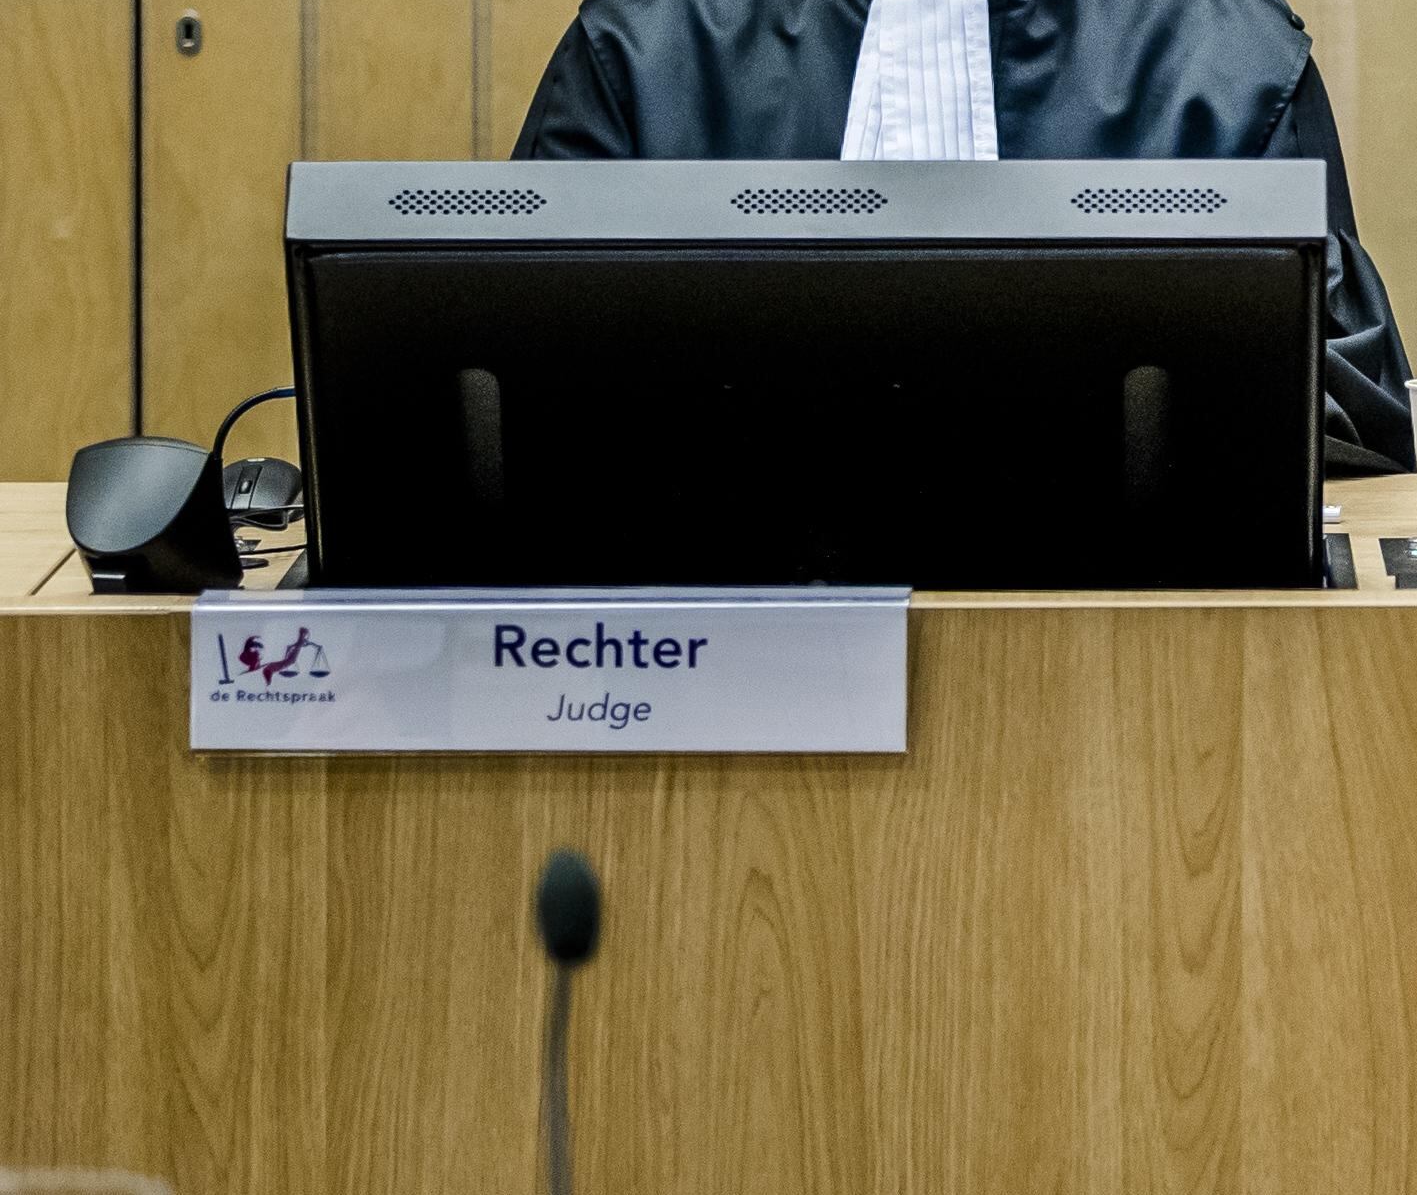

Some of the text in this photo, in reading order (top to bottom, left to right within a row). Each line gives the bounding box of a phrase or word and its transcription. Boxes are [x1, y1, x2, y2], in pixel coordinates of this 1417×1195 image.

[492, 621, 709, 669] Rechter
[209, 688, 336, 706] de Rechtspraak
[545, 691, 653, 731] Judge
